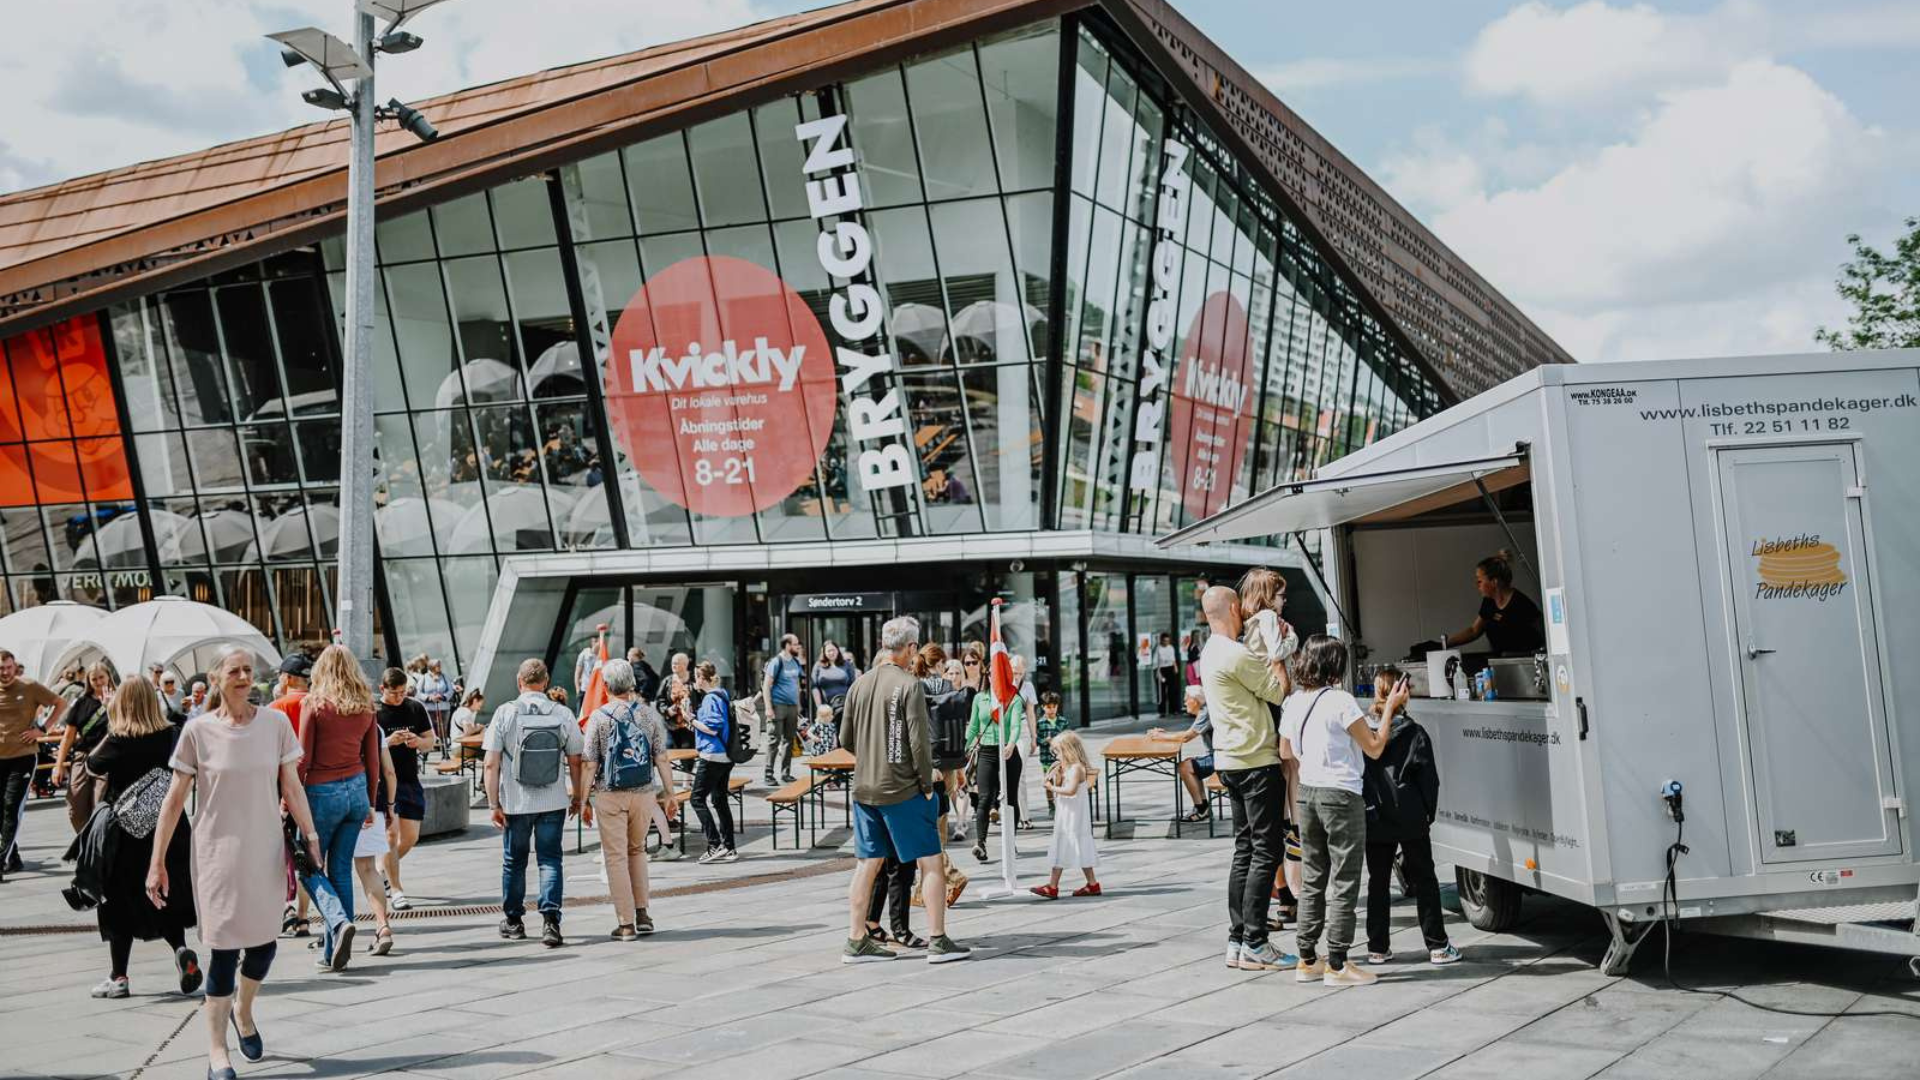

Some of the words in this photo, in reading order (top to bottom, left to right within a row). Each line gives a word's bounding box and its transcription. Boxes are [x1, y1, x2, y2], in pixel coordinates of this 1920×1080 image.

[796, 114, 913, 490] BRYGGEN
[629, 337, 806, 393] Kvickly
[671, 397, 687, 410] Dit
[689, 396, 721, 409] lokale
[1640, 394, 1917, 421] www.lisbethspandekager.dk
[680, 417, 765, 435] Åbningstider
[1710, 423, 1738, 436] Tlf.
[1744, 421, 1766, 434] 22
[1773, 420, 1791, 433] 51
[1801, 418, 1819, 431] 11
[1828, 417, 1850, 430] 82
[693, 440, 719, 452] Alle
[721, 437, 755, 453] dage
[695, 457, 756, 486] 8-21
[1751, 533, 1820, 556] Lisbeths
[808, 597, 855, 608] Søndertorv
[856, 596, 863, 606] 2
[1755, 579, 1848, 602] Pandekager
